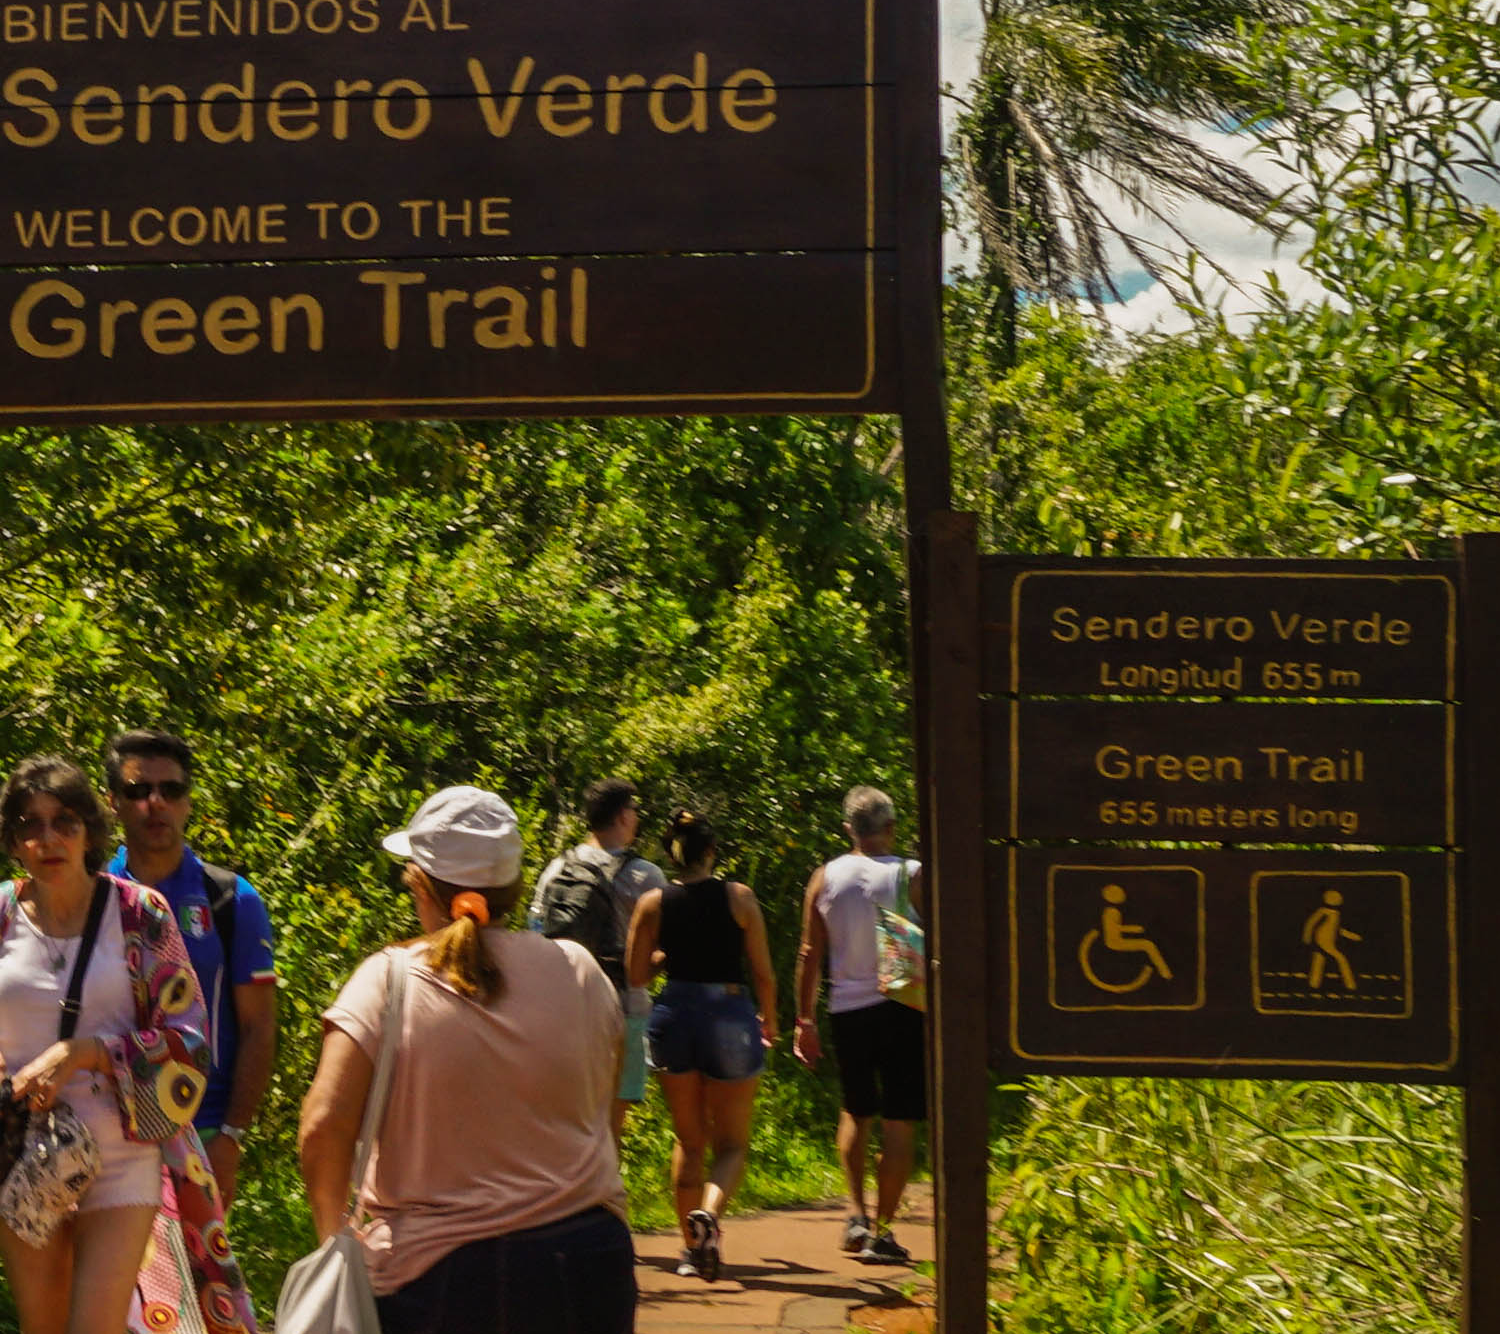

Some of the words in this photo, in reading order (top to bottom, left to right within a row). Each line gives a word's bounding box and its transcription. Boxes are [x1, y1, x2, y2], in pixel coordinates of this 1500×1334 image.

[3, 63, 431, 146] Sendero
[468, 52, 776, 137] Verde
[14, 204, 286, 247] WELCOME
[308, 201, 379, 240] TO
[401, 197, 510, 236] THE
[11, 280, 323, 358] Green
[360, 268, 587, 349] Trail
[1052, 607, 1254, 642] Sendero
[1271, 611, 1411, 646] Verde
[1101, 657, 1242, 694] Longitud
[1096, 744, 1242, 782] Green
[1260, 747, 1363, 783] Trail
[1100, 801, 1158, 825] 655
[1168, 806, 1278, 828] meters
[1288, 804, 1360, 835] long
